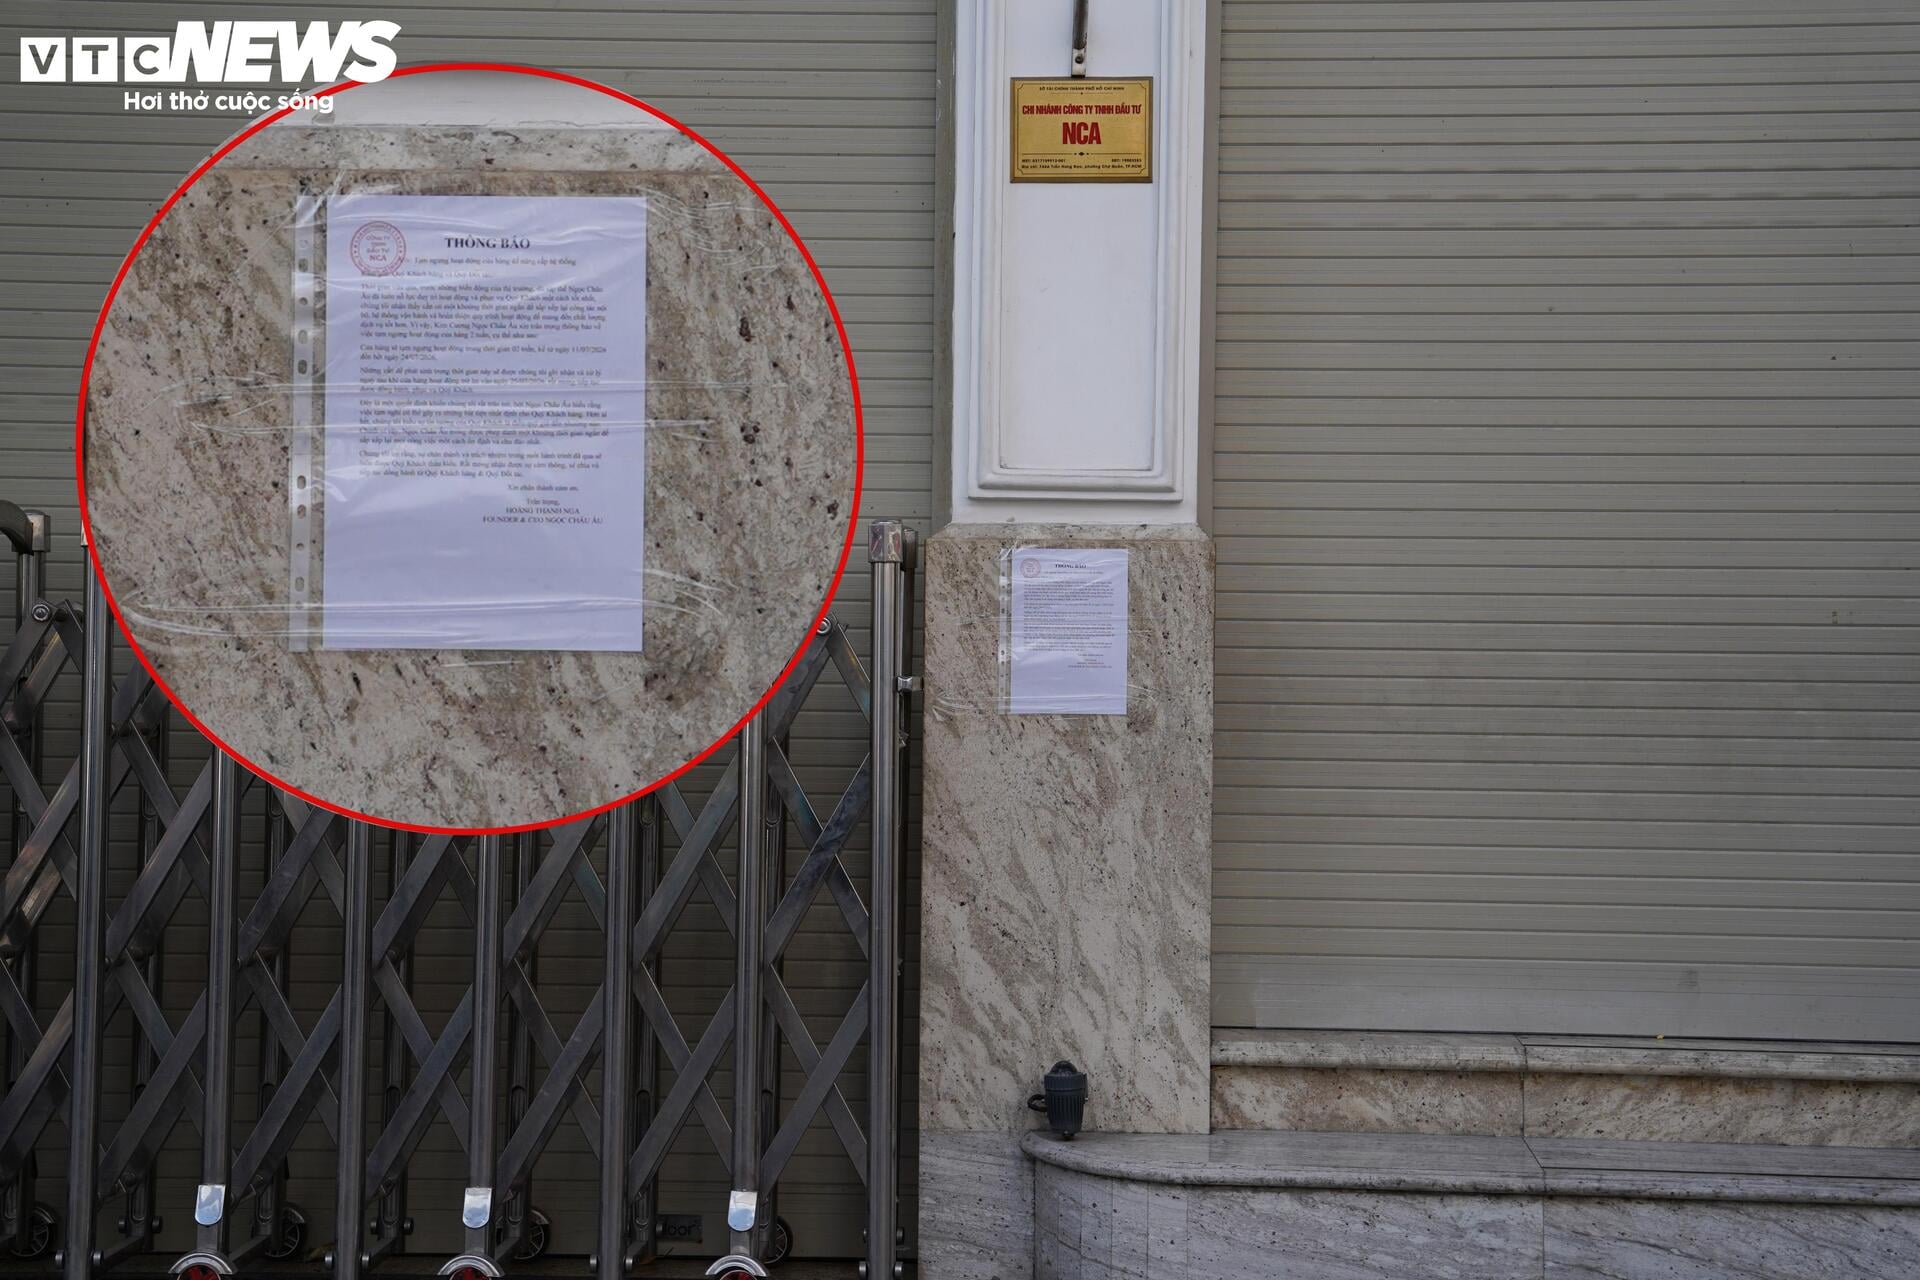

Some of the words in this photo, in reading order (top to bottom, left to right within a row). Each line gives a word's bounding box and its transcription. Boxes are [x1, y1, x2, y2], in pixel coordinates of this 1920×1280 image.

[1022, 105, 1034, 114] CHI
[1036, 104, 1061, 114] NHÁNH
[1063, 103, 1083, 114] CÔNG
[1084, 105, 1093, 114] TY
[1094, 105, 1114, 114] TNHH
[1115, 102, 1130, 114] ĐẦU
[1131, 104, 1142, 114] TƯ
[1062, 122, 1101, 144] NCA
[445, 234, 497, 248] THÔNG
[501, 235, 530, 249] BÁO
